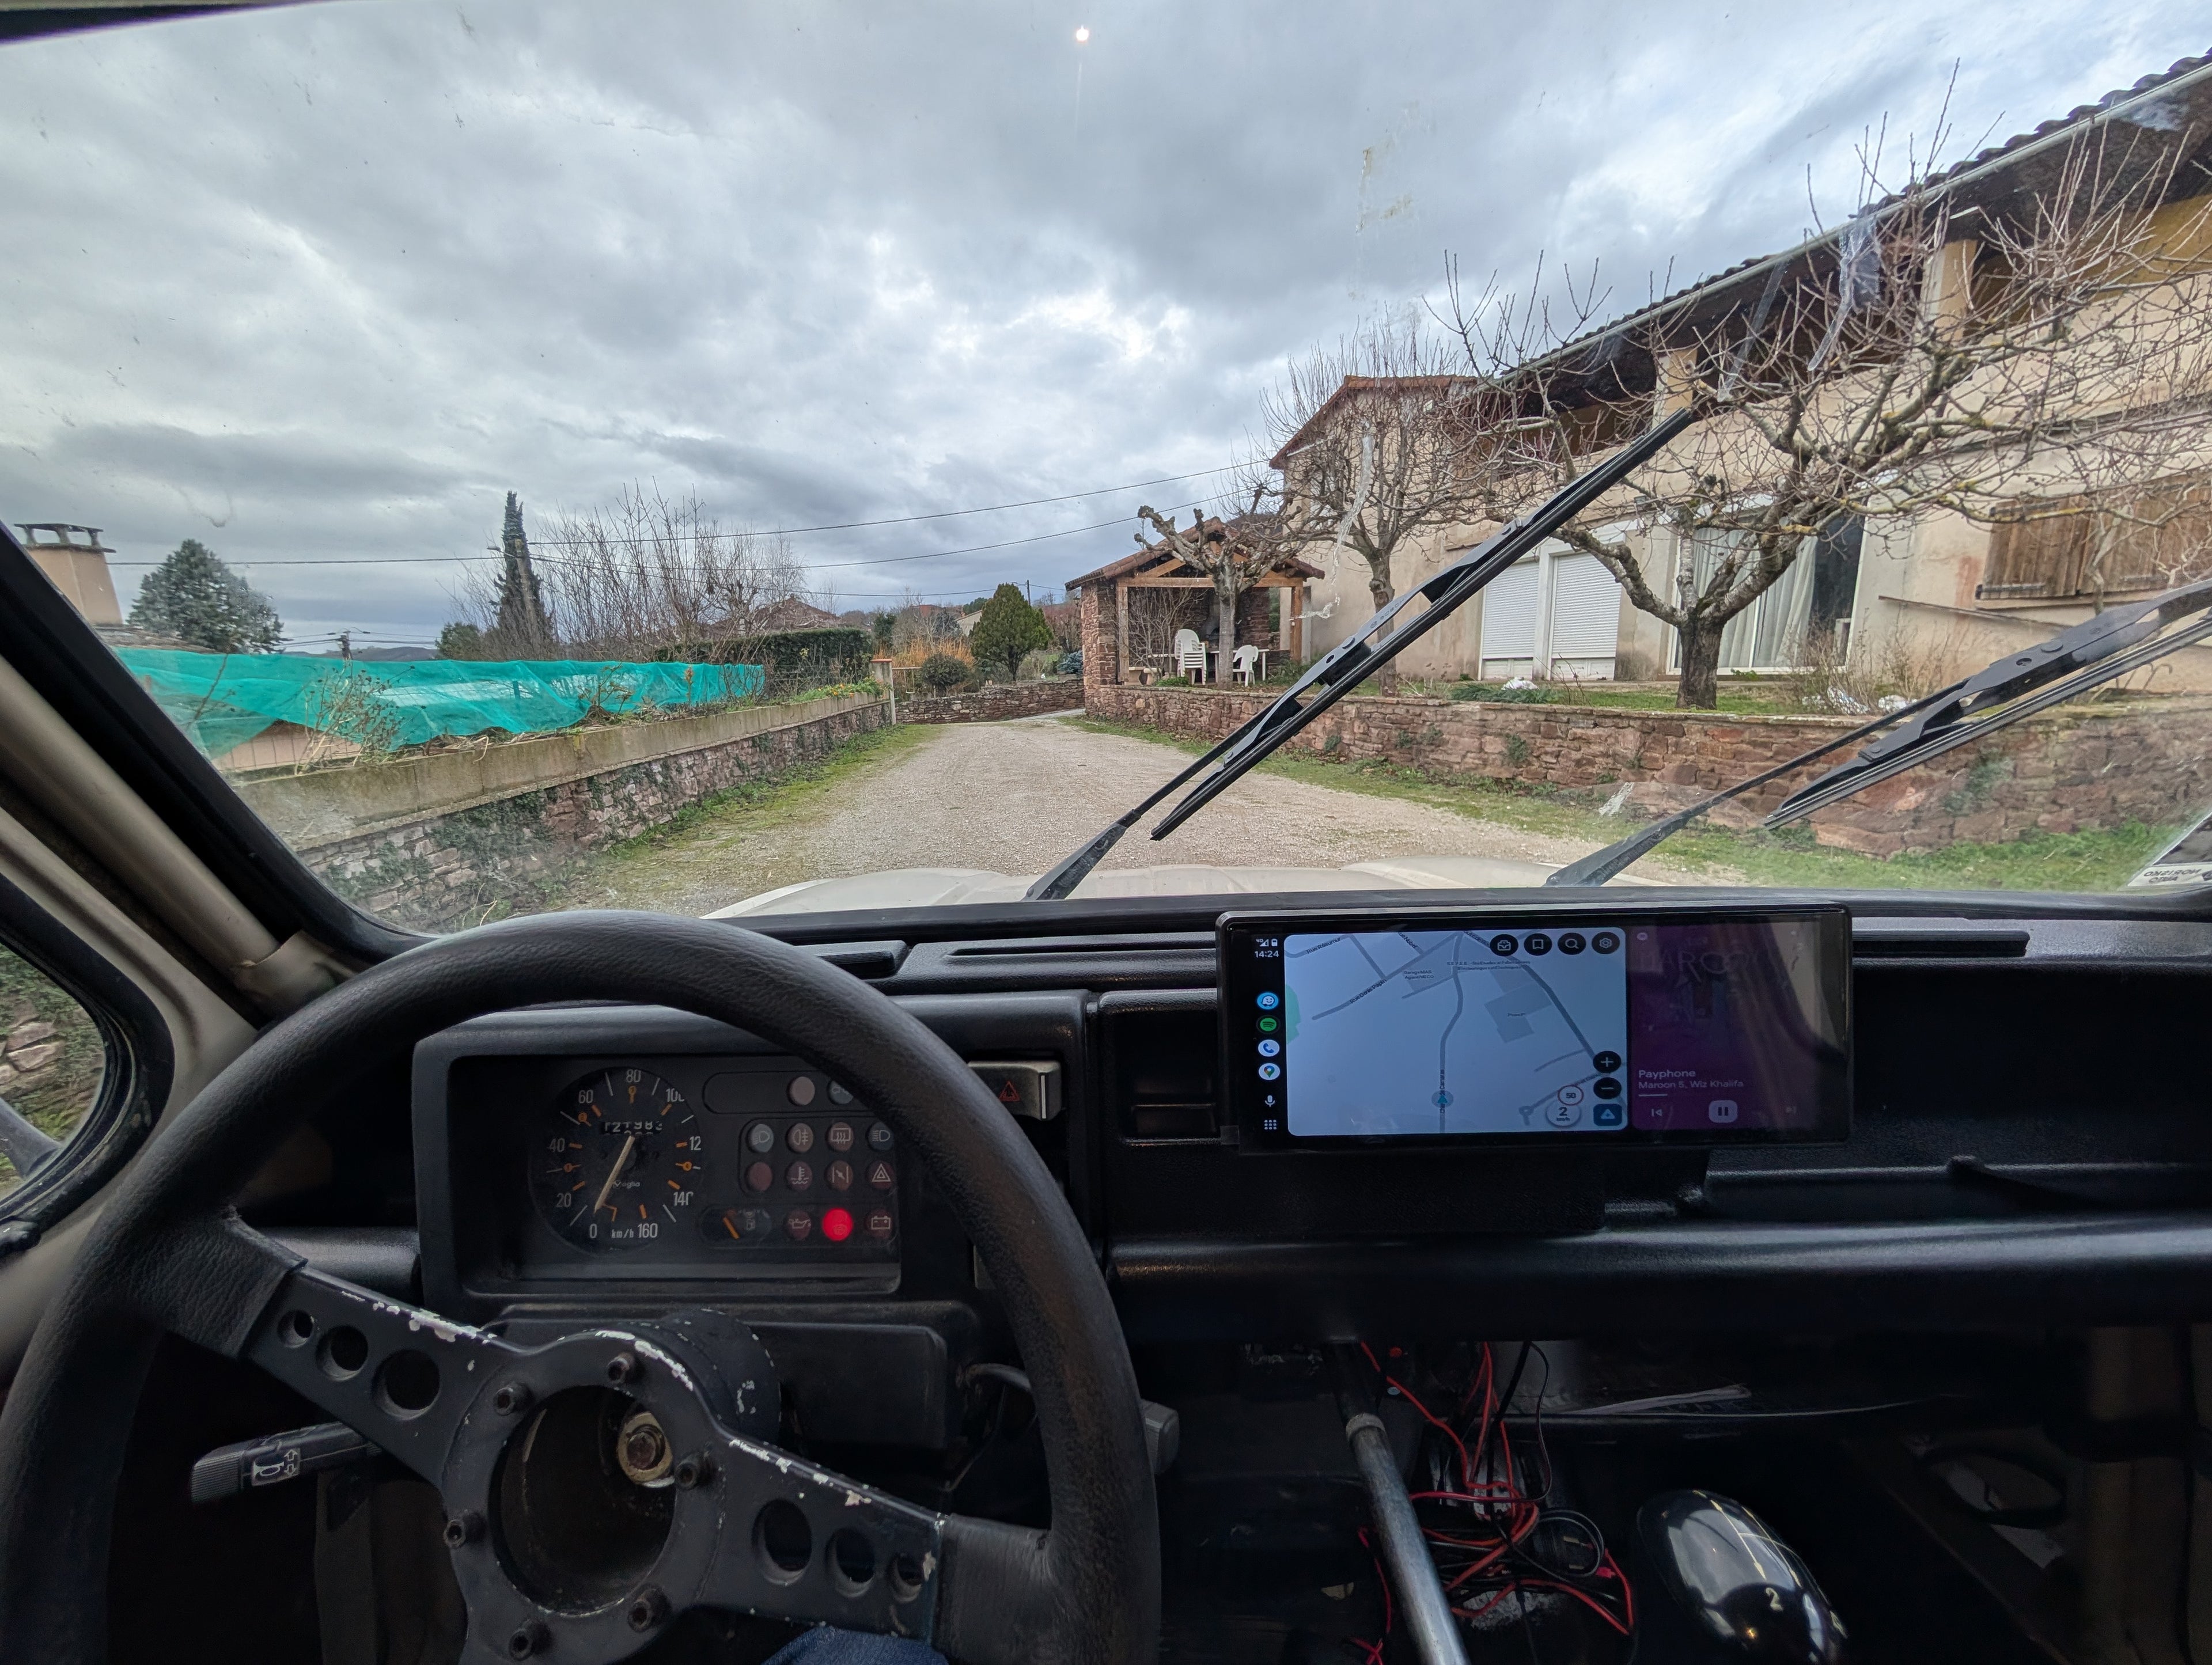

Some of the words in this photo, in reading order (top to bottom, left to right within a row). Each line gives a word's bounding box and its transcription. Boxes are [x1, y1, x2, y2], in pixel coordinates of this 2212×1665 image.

[1255, 950, 1279, 958] 14:24
[1306, 946, 1318, 954] Rue
[1349, 995, 1360, 1004] Rue
[626, 1069, 641, 1083] 80
[1638, 1069, 1696, 1080] Payphone
[1710, 1079, 1744, 1088] Khalifa
[578, 1090, 593, 1103] 60
[1559, 1106, 1567, 1116] 2
[547, 1138, 565, 1152] 40
[556, 1193, 572, 1207] 20
[589, 1224, 597, 1238] 0
[611, 1228, 634, 1238] km/h
[637, 1223, 658, 1238] 160
[1765, 1587, 1784, 1612] 2
